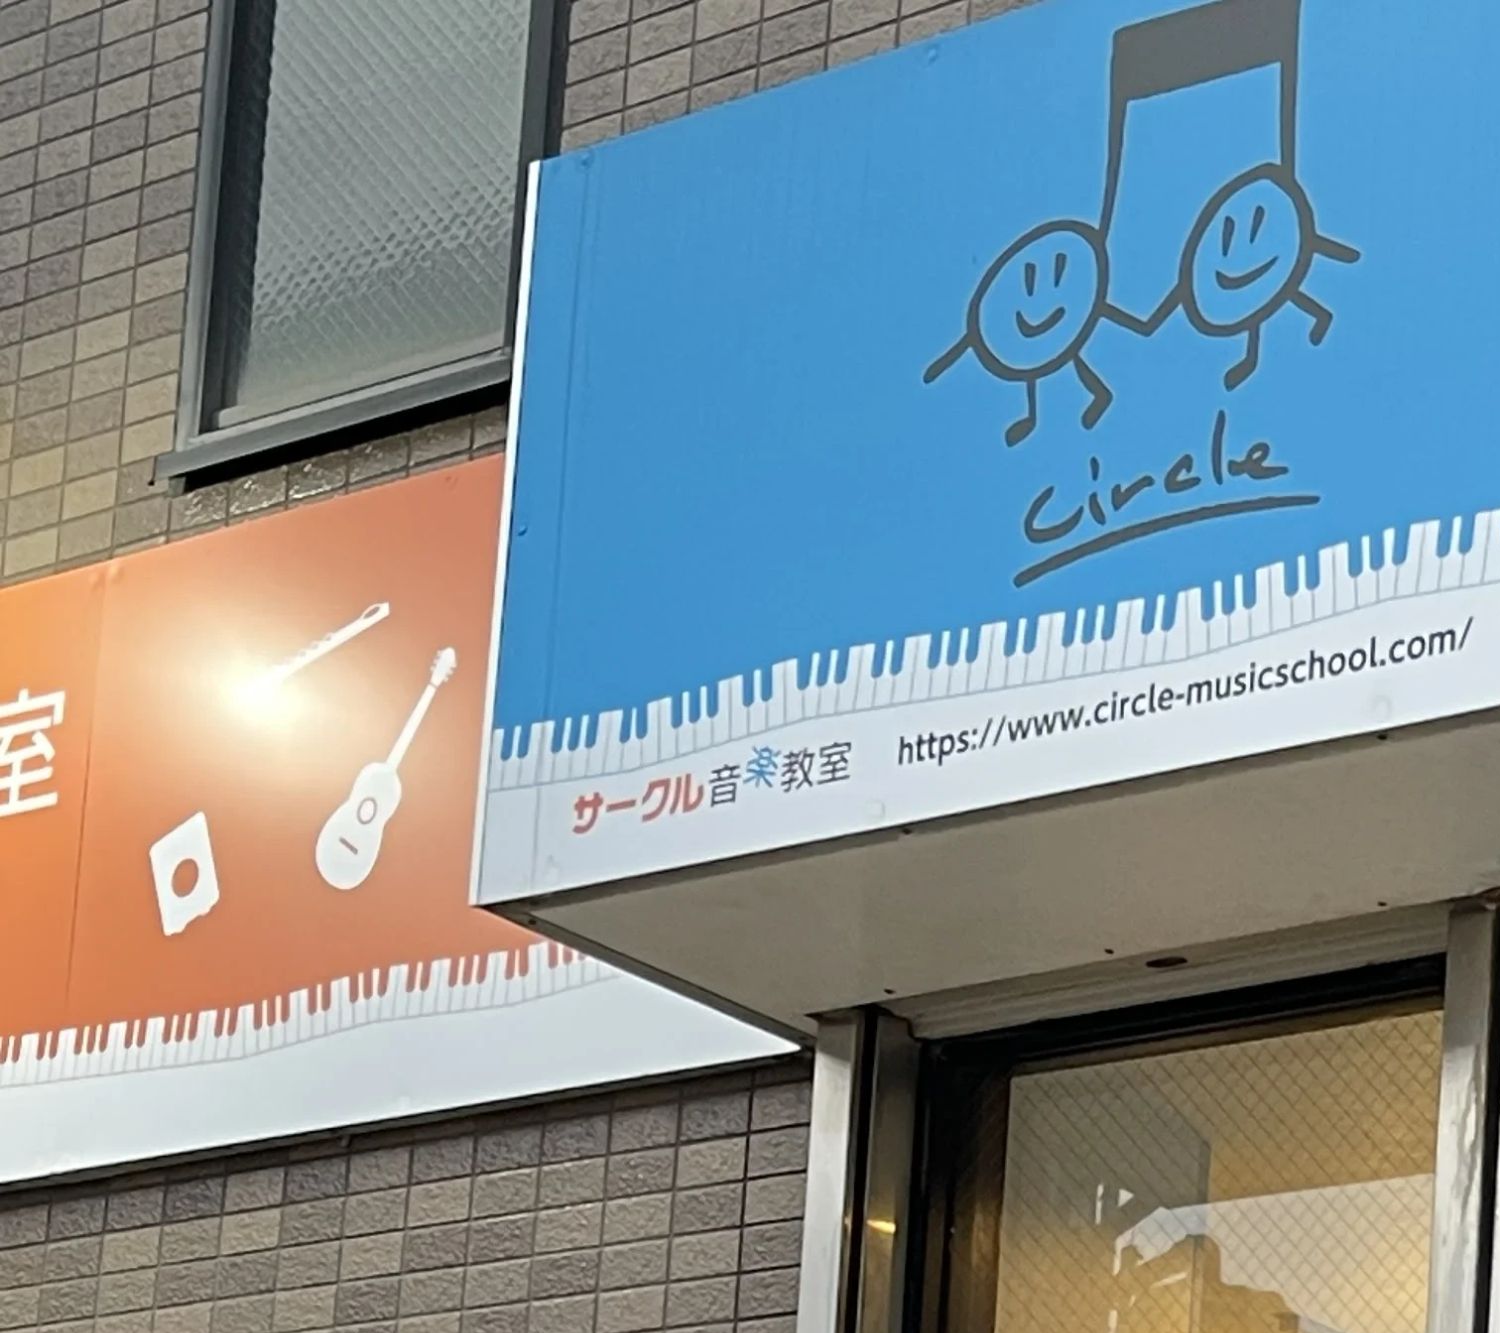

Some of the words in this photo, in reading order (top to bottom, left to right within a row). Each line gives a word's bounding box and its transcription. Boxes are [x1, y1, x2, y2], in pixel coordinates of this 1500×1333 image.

[572, 741, 852, 835] サークル音楽教室
[898, 615, 1475, 767] https://www.circle-musicschool.com/
